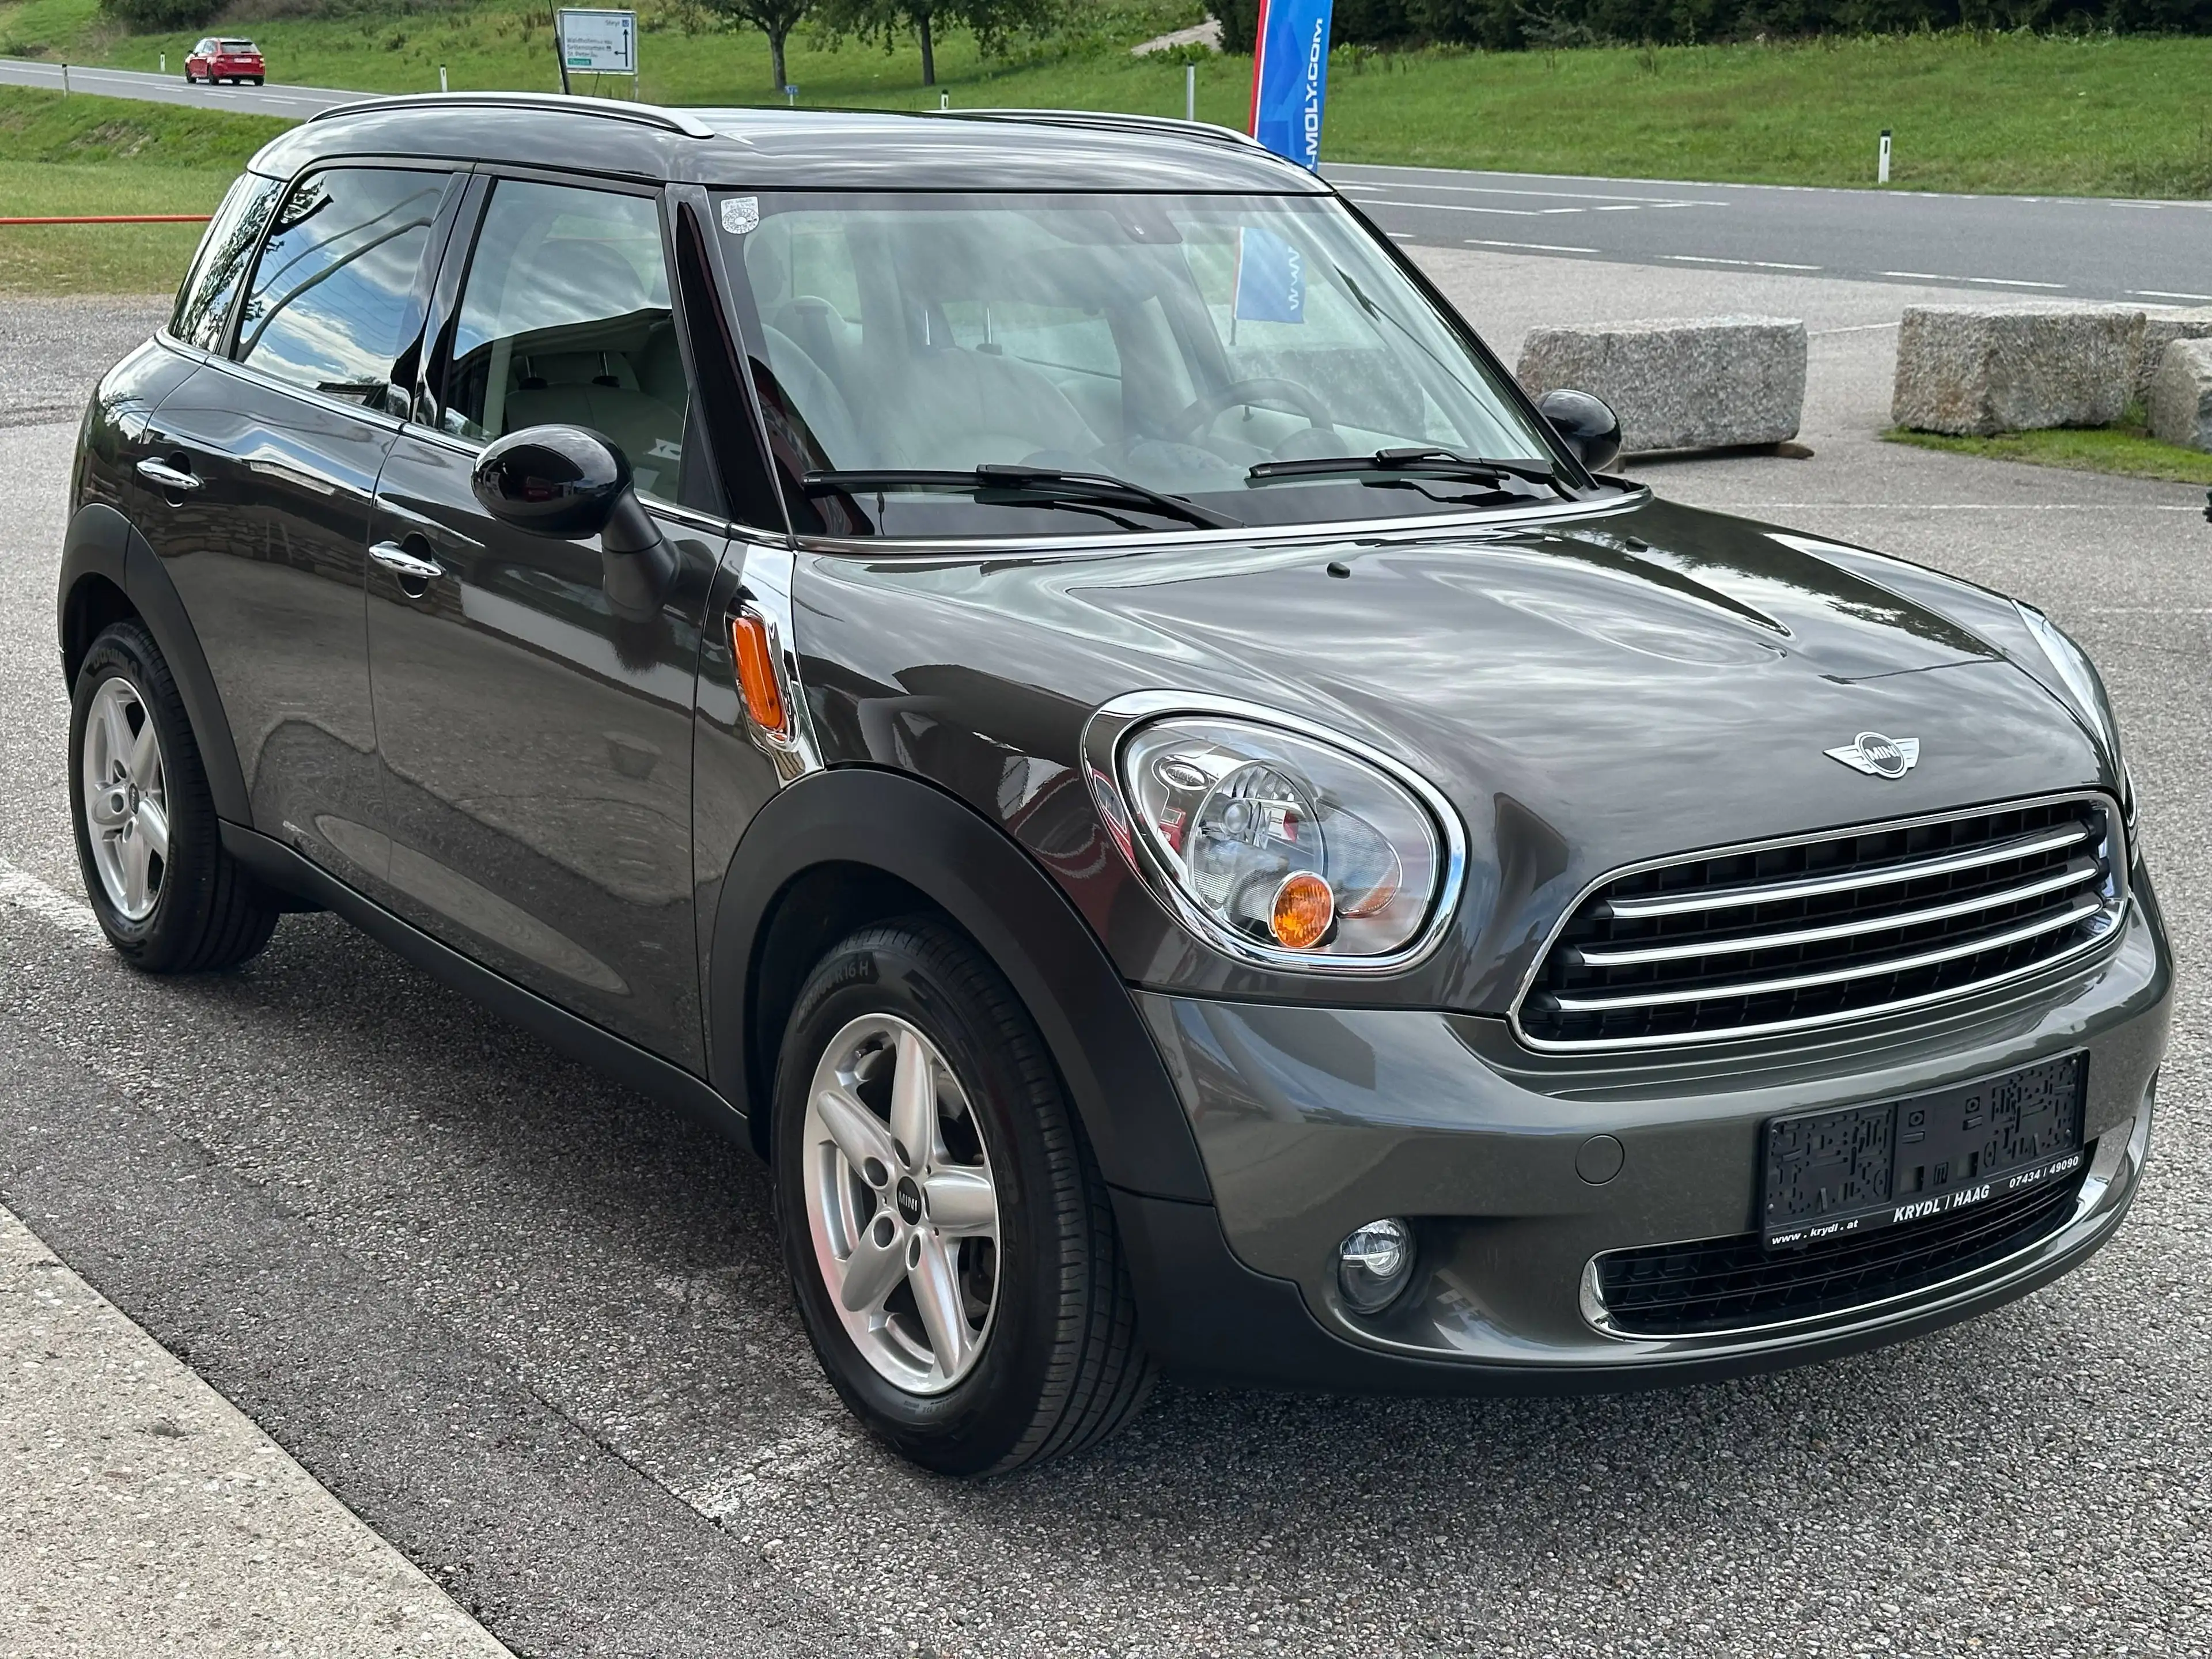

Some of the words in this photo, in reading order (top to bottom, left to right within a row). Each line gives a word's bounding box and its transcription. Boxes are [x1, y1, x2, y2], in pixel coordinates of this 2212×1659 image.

[1865, 745, 1900, 762] MINI
[859, 960, 869, 977] H
[2009, 1169, 2040, 1188] 07434
[2049, 1156, 2079, 1175] 49090
[898, 1191, 918, 1212] MINI
[1893, 1199, 1941, 1222] KRYDL
[1953, 1184, 1991, 1207] HAAG
